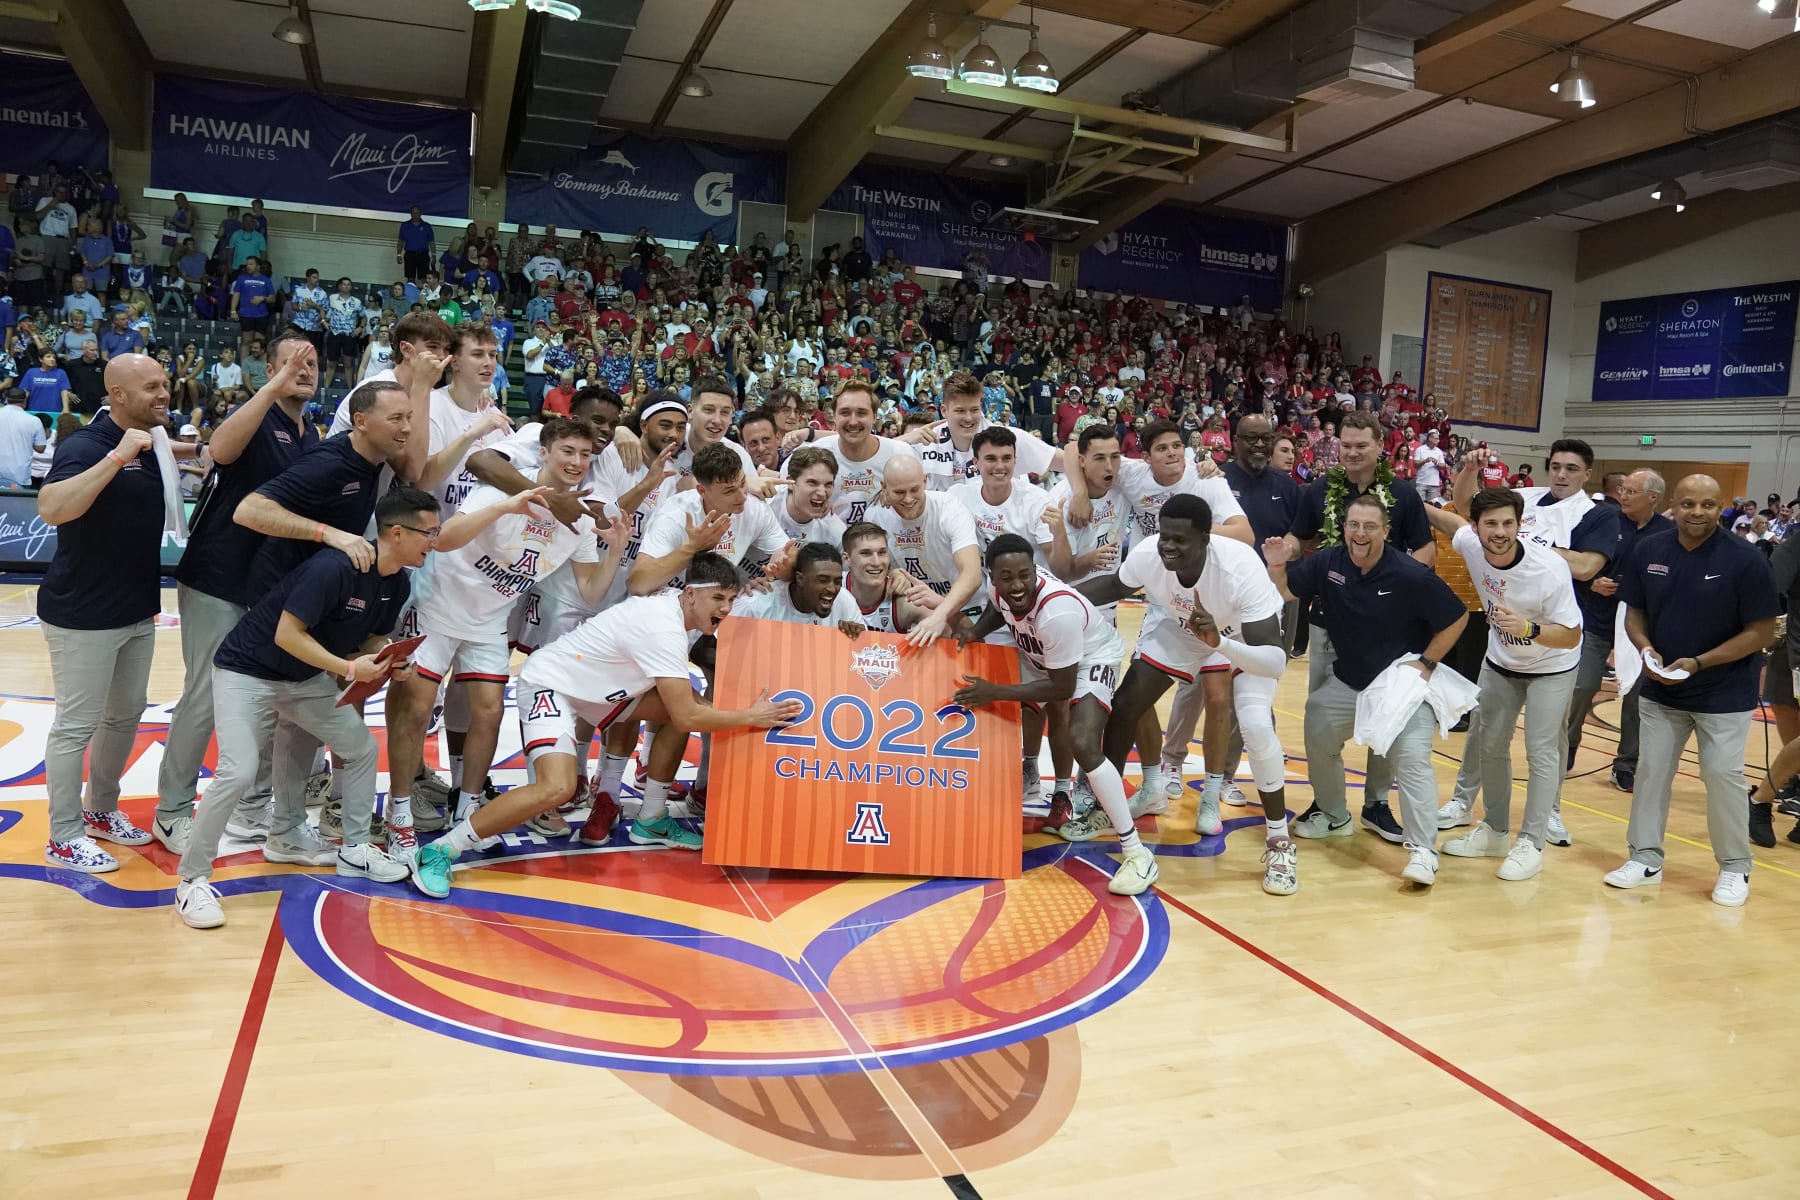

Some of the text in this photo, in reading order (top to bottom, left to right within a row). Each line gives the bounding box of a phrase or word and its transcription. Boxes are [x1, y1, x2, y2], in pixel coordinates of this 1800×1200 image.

[169, 113, 311, 150] HAWAIIAN
[330, 132, 457, 194] Maui Jim
[553, 172, 680, 202] Tommy Bahama
[694, 171, 734, 217] G
[852, 185, 941, 212] THE WESTIN
[871, 219, 898, 229] RESORT
[1123, 231, 1169, 248] HYATT
[1121, 244, 1182, 262] REGENCY
[1200, 244, 1250, 264] hmsa
[1733, 293, 1791, 306] THE WESTIN
[1659, 319, 1720, 332] SHERATON
[1660, 366, 1691, 375] hmsa
[845, 479, 871, 487] MAUI
[526, 523, 550, 538] MAU
[977, 520, 1001, 532] MAUI
[509, 549, 540, 576] A
[904, 558, 928, 580] A
[474, 555, 535, 593] CHAMPIO
[492, 582, 516, 598] 2022
[857, 657, 895, 669] MAUI
[528, 689, 561, 721] A
[765, 689, 979, 761] 2022
[774, 757, 970, 790] CHAMPIONS
[846, 802, 890, 845] A
